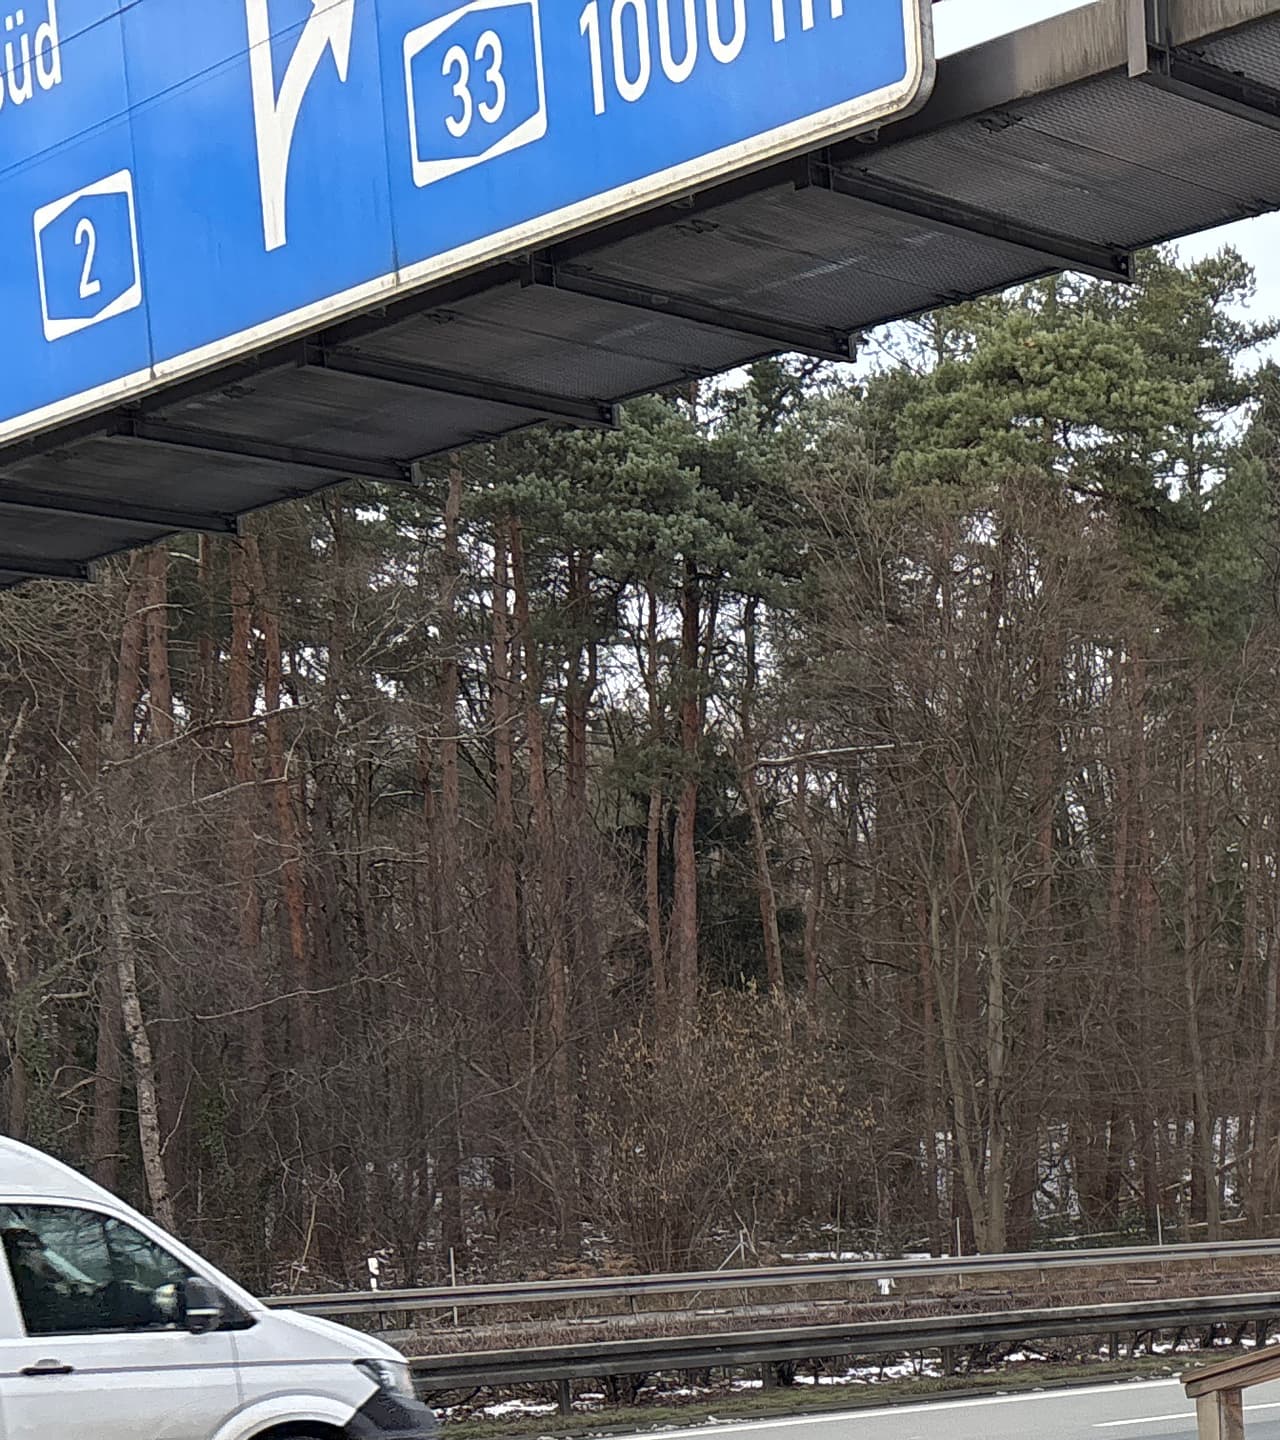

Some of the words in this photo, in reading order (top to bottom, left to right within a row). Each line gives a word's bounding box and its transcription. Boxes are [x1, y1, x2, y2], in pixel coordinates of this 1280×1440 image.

[0, 0, 62, 111] üd
[441, 30, 507, 138] 33
[580, 0, 747, 116] 1000
[73, 218, 101, 299] 2
